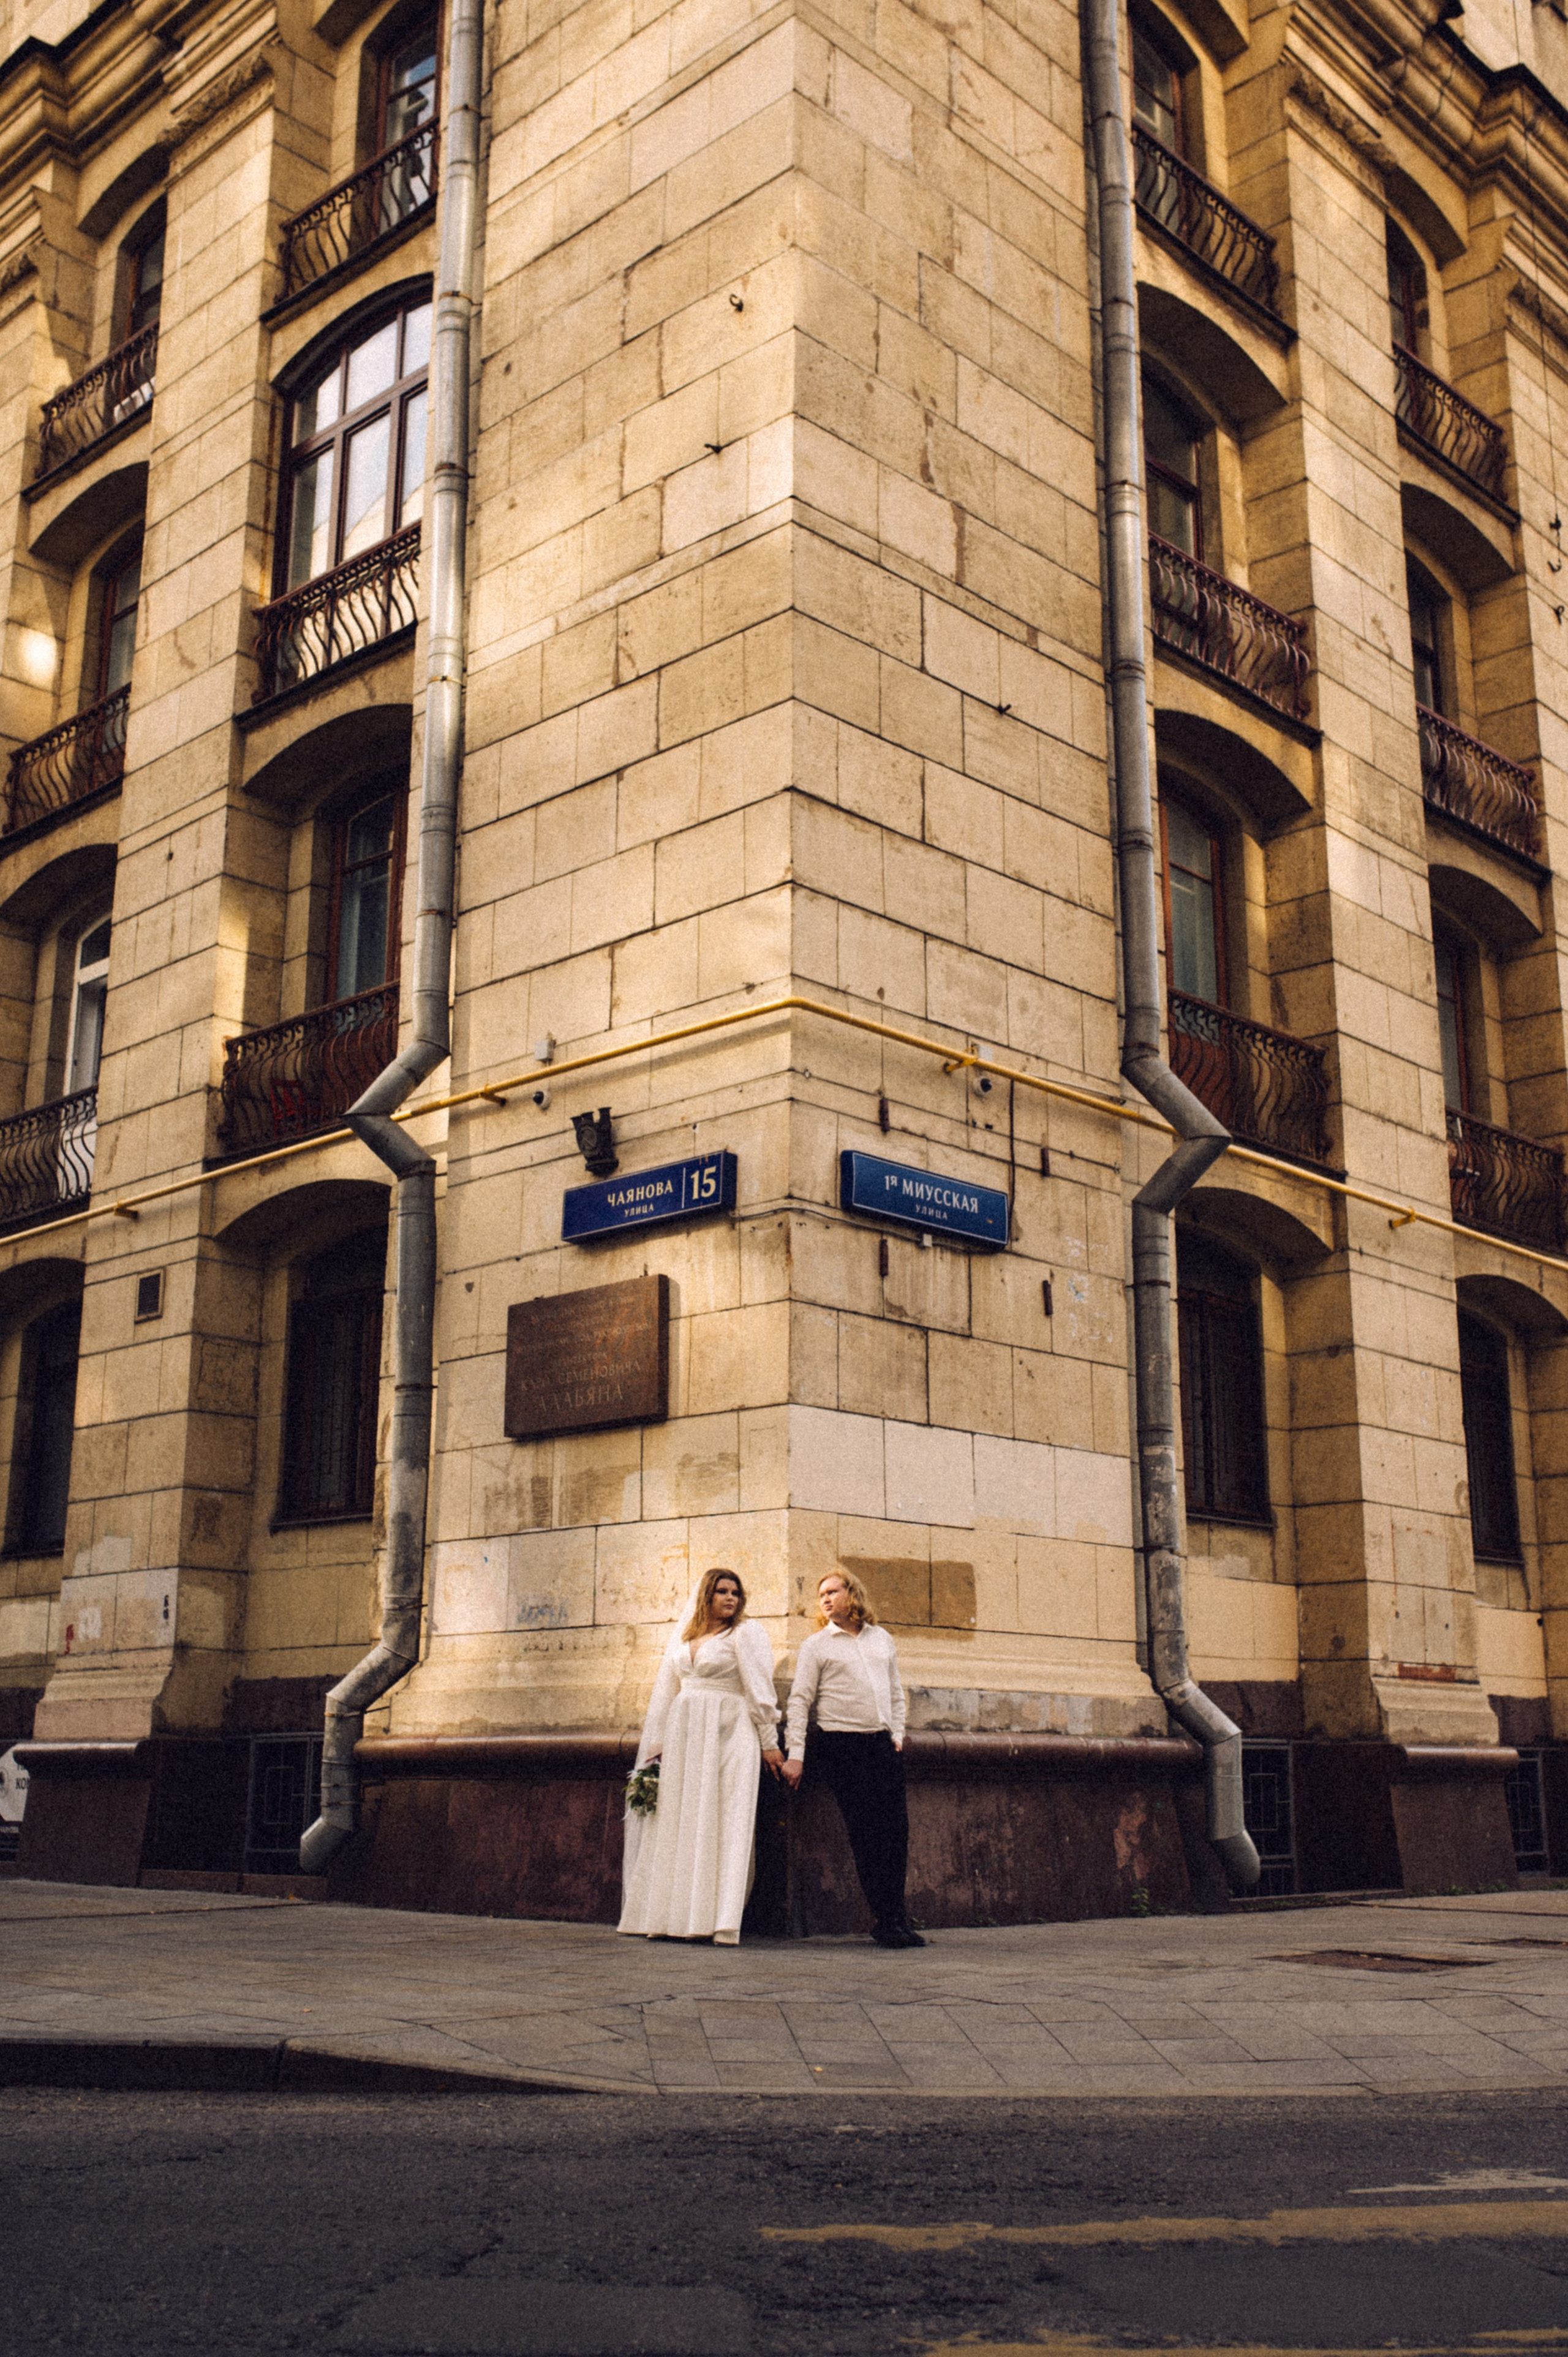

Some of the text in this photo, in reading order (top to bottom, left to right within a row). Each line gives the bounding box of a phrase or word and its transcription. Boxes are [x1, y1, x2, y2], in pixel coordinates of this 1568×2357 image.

[608, 1166, 717, 1206] ЧАЯНОВА 15
[902, 1178, 979, 1213] МИУССКАЯ
[624, 1203, 654, 1218] УЛИЦА
[915, 1204, 948, 1221] УЛИЦА
